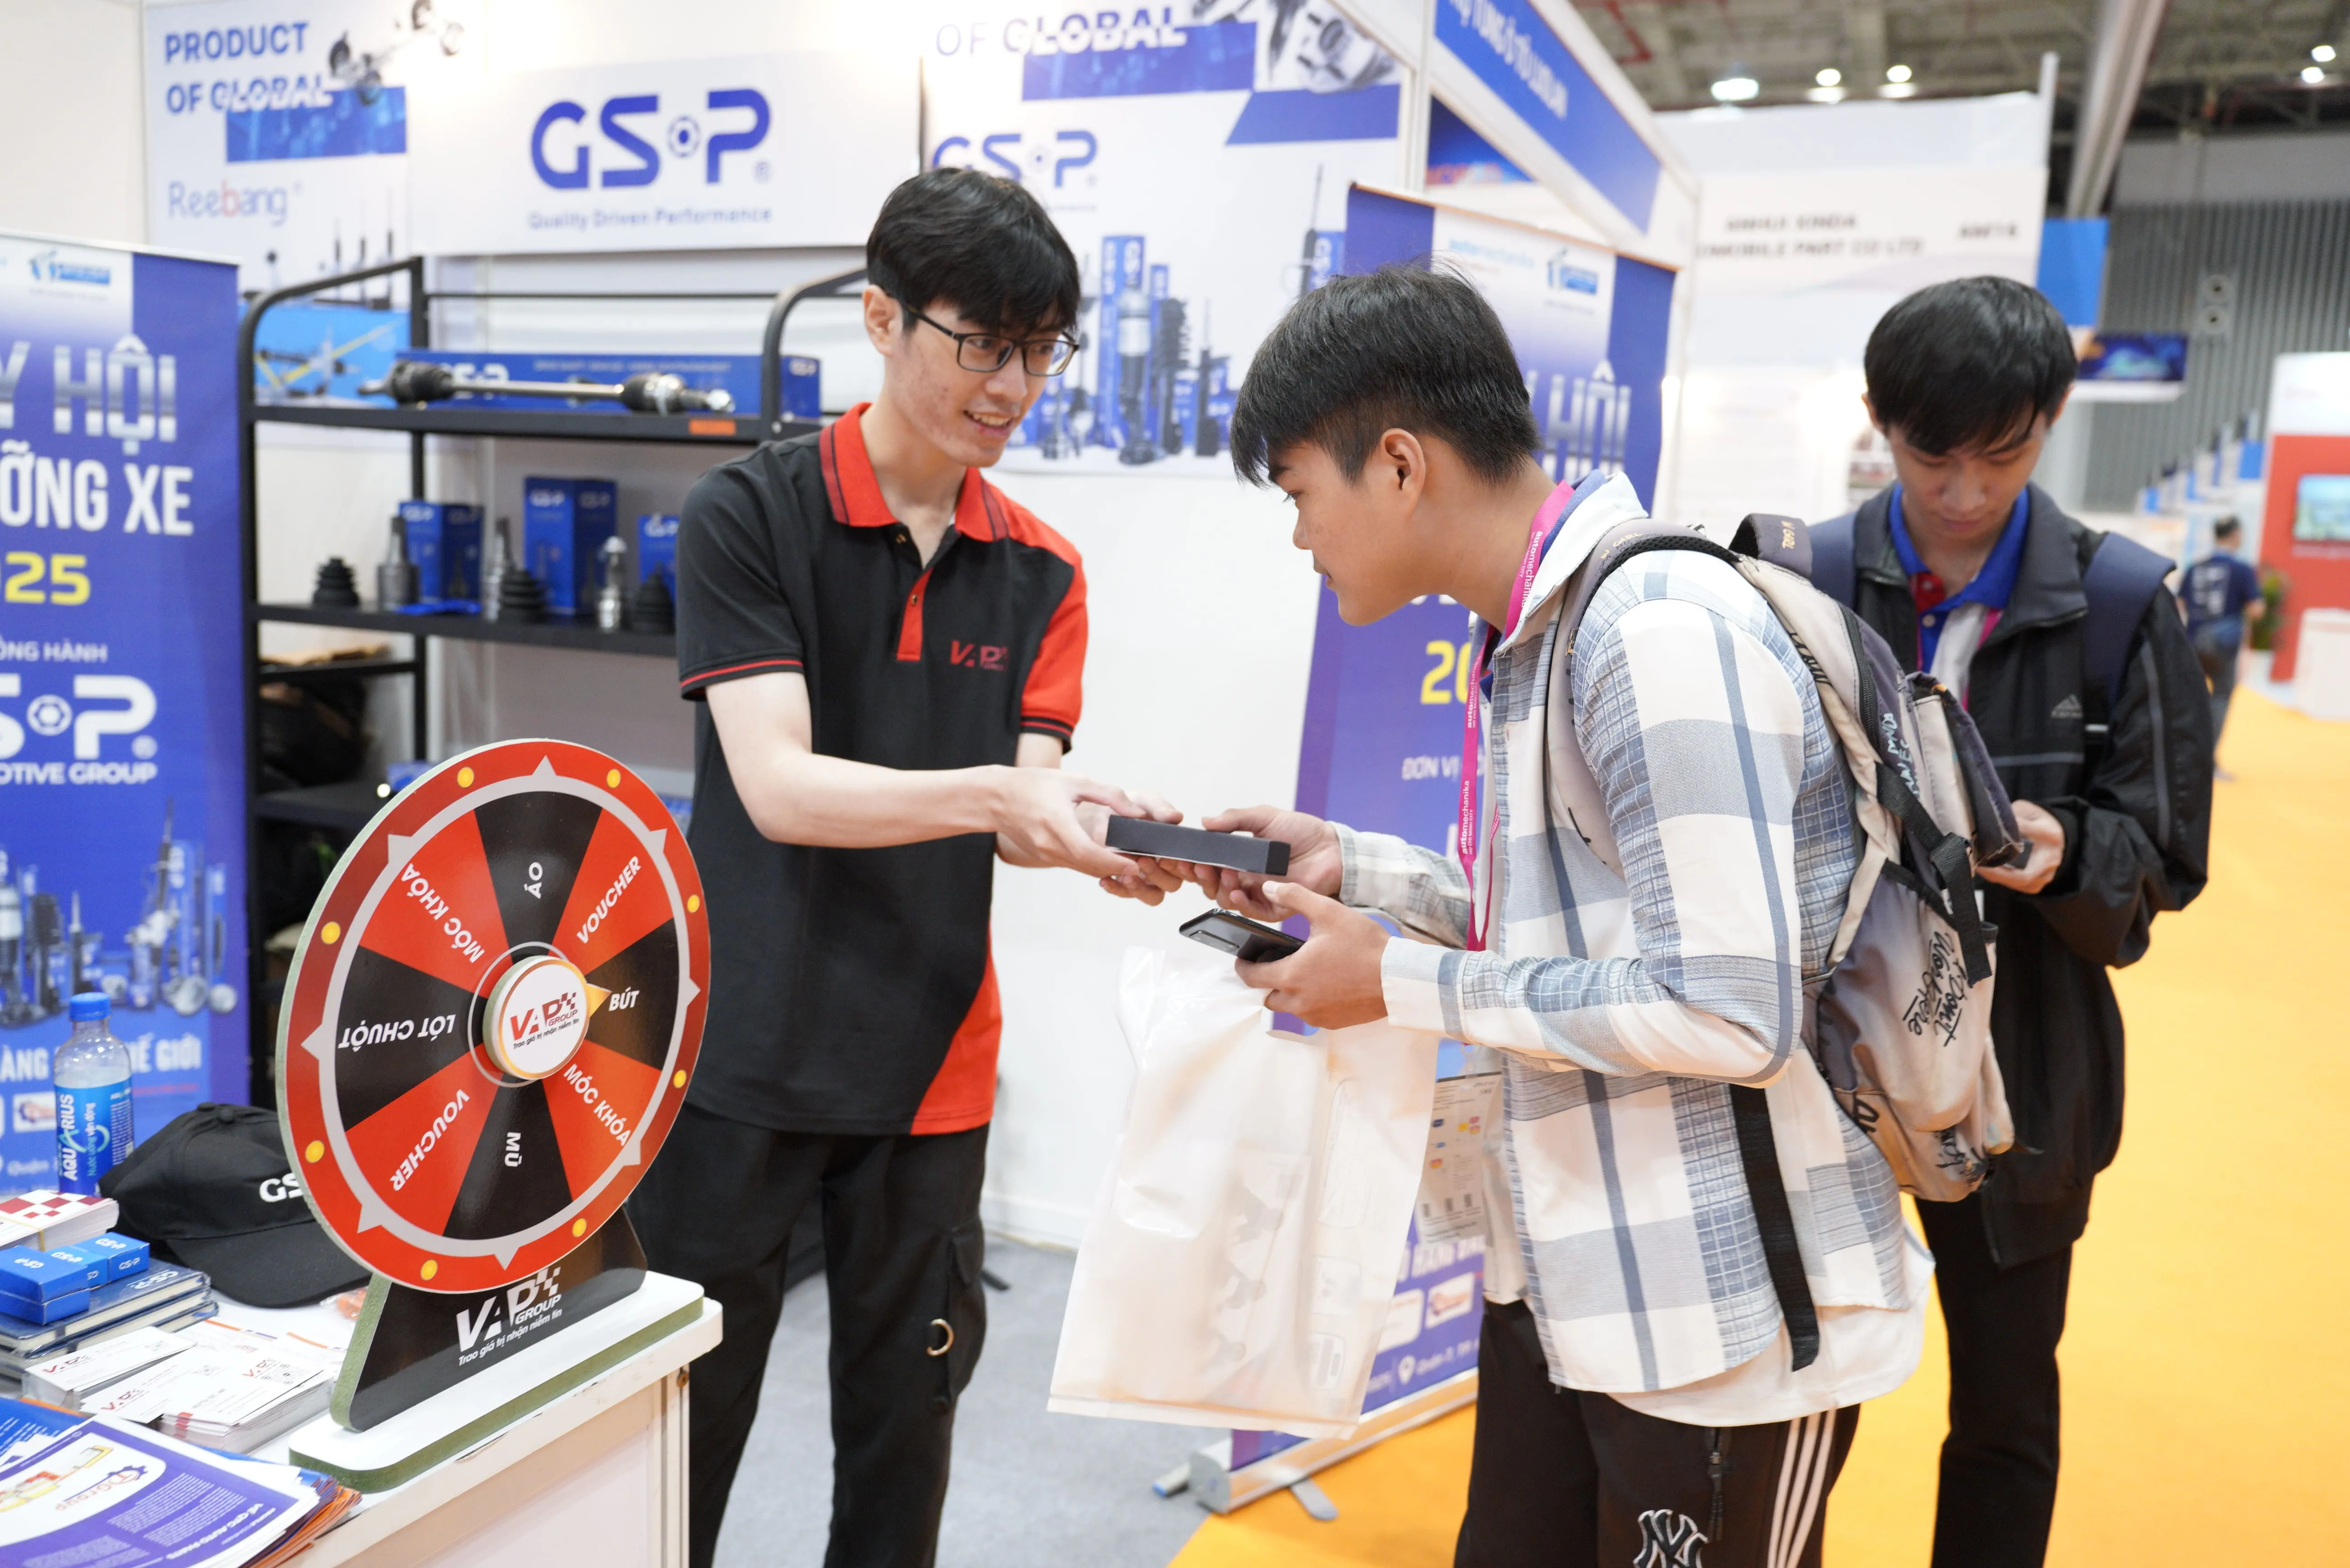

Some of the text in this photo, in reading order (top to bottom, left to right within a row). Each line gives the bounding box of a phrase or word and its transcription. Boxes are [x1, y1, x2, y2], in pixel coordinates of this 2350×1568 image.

[165, 22, 310, 64] PRODUCT
[936, 7, 1186, 57] OF GLOBAL
[166, 73, 334, 114] OF GLOBAL
[168, 181, 287, 226] Reebang
[528, 211, 588, 232] Quality
[656, 207, 772, 225] Performance
[54, 333, 176, 454] HỘI
[123, 463, 194, 536] XE
[44, 638, 108, 663] HÀNH
[68, 762, 158, 786] GROUP
[1460, 780, 1471, 855] automechanika
[524, 861, 543, 900] ÁO
[576, 856, 642, 945] VOUCHER
[400, 862, 485, 963] MÓC KHÓA
[548, 1009, 578, 1027] GROUP
[608, 986, 639, 1012] BÚT
[155, 1031, 202, 1072] GIỚI
[338, 1014, 456, 1051] LÓT CHUỘT
[513, 1040, 525, 1050] Trao
[526, 1035, 535, 1045] giá
[564, 1063, 630, 1146] MÓC KHÓA
[59, 1094, 80, 1181] AQUARIUS
[389, 1089, 470, 1191] VOUCHER
[504, 1131, 522, 1168] MŨ
[514, 1293, 562, 1325] GROUP
[458, 1350, 479, 1367] Trao
[479, 1340, 496, 1359] giá
[496, 1334, 507, 1348] trị
[506, 1325, 529, 1339] nhận
[551, 1308, 562, 1321] tin
